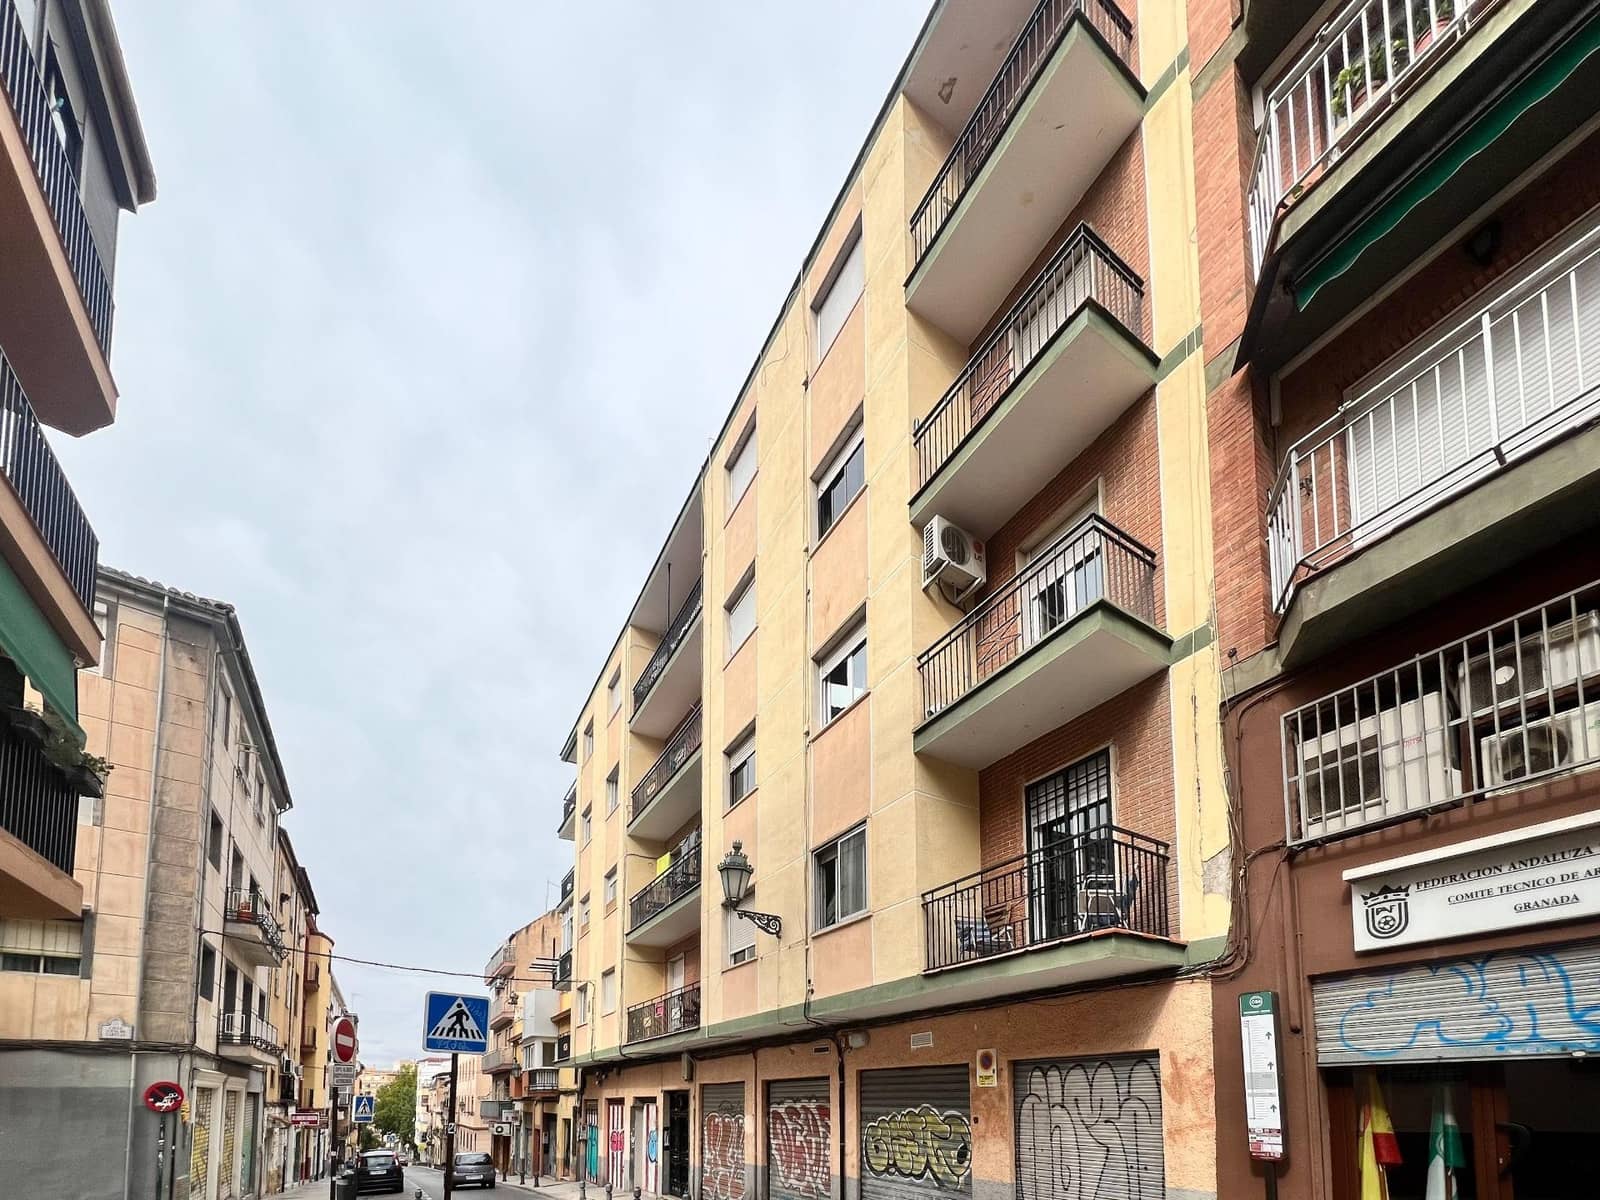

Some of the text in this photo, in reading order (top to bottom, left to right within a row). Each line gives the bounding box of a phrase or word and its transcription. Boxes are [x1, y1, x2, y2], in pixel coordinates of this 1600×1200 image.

[1416, 845, 1594, 891] FEDERACION ANDALUZA
[1448, 887, 1495, 903] COMITE
[1498, 876, 1556, 895] TECNICO
[1560, 871, 1580, 882] DE
[1513, 893, 1580, 913] GRANADA
